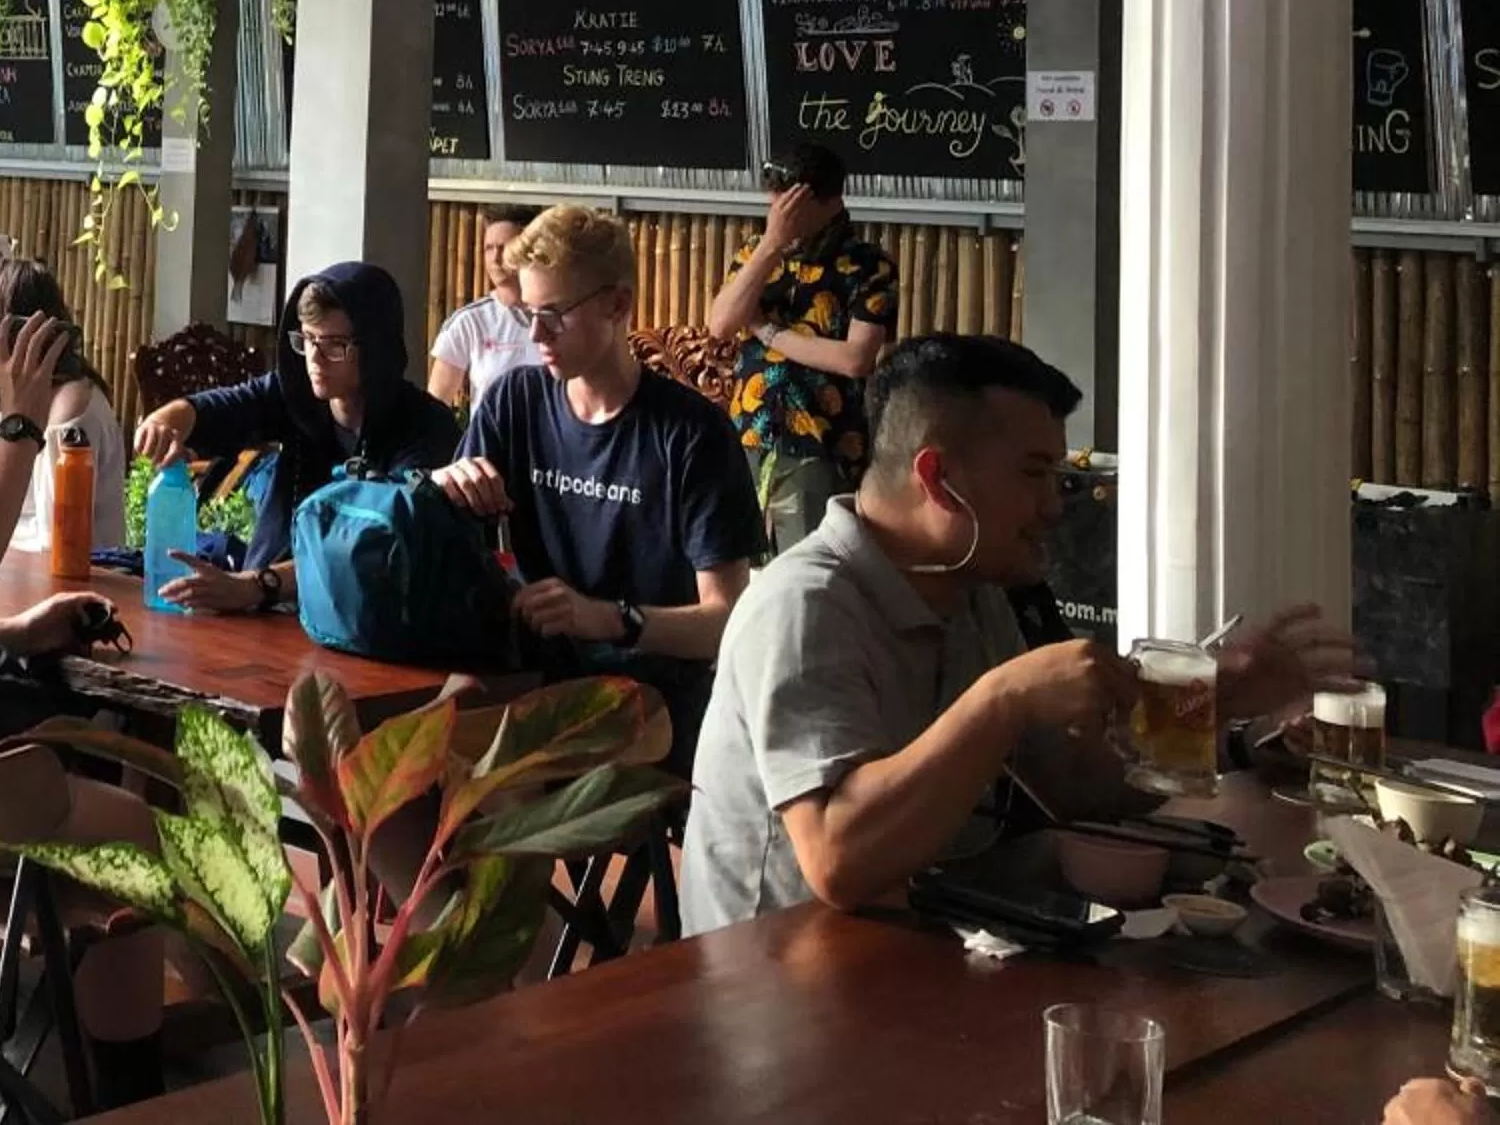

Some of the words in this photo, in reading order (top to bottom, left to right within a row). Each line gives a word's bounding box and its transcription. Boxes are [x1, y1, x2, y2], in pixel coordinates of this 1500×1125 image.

[794, 40, 897, 72] LOVE
[799, 90, 850, 130] the
[531, 467, 642, 504] ntipodeans
